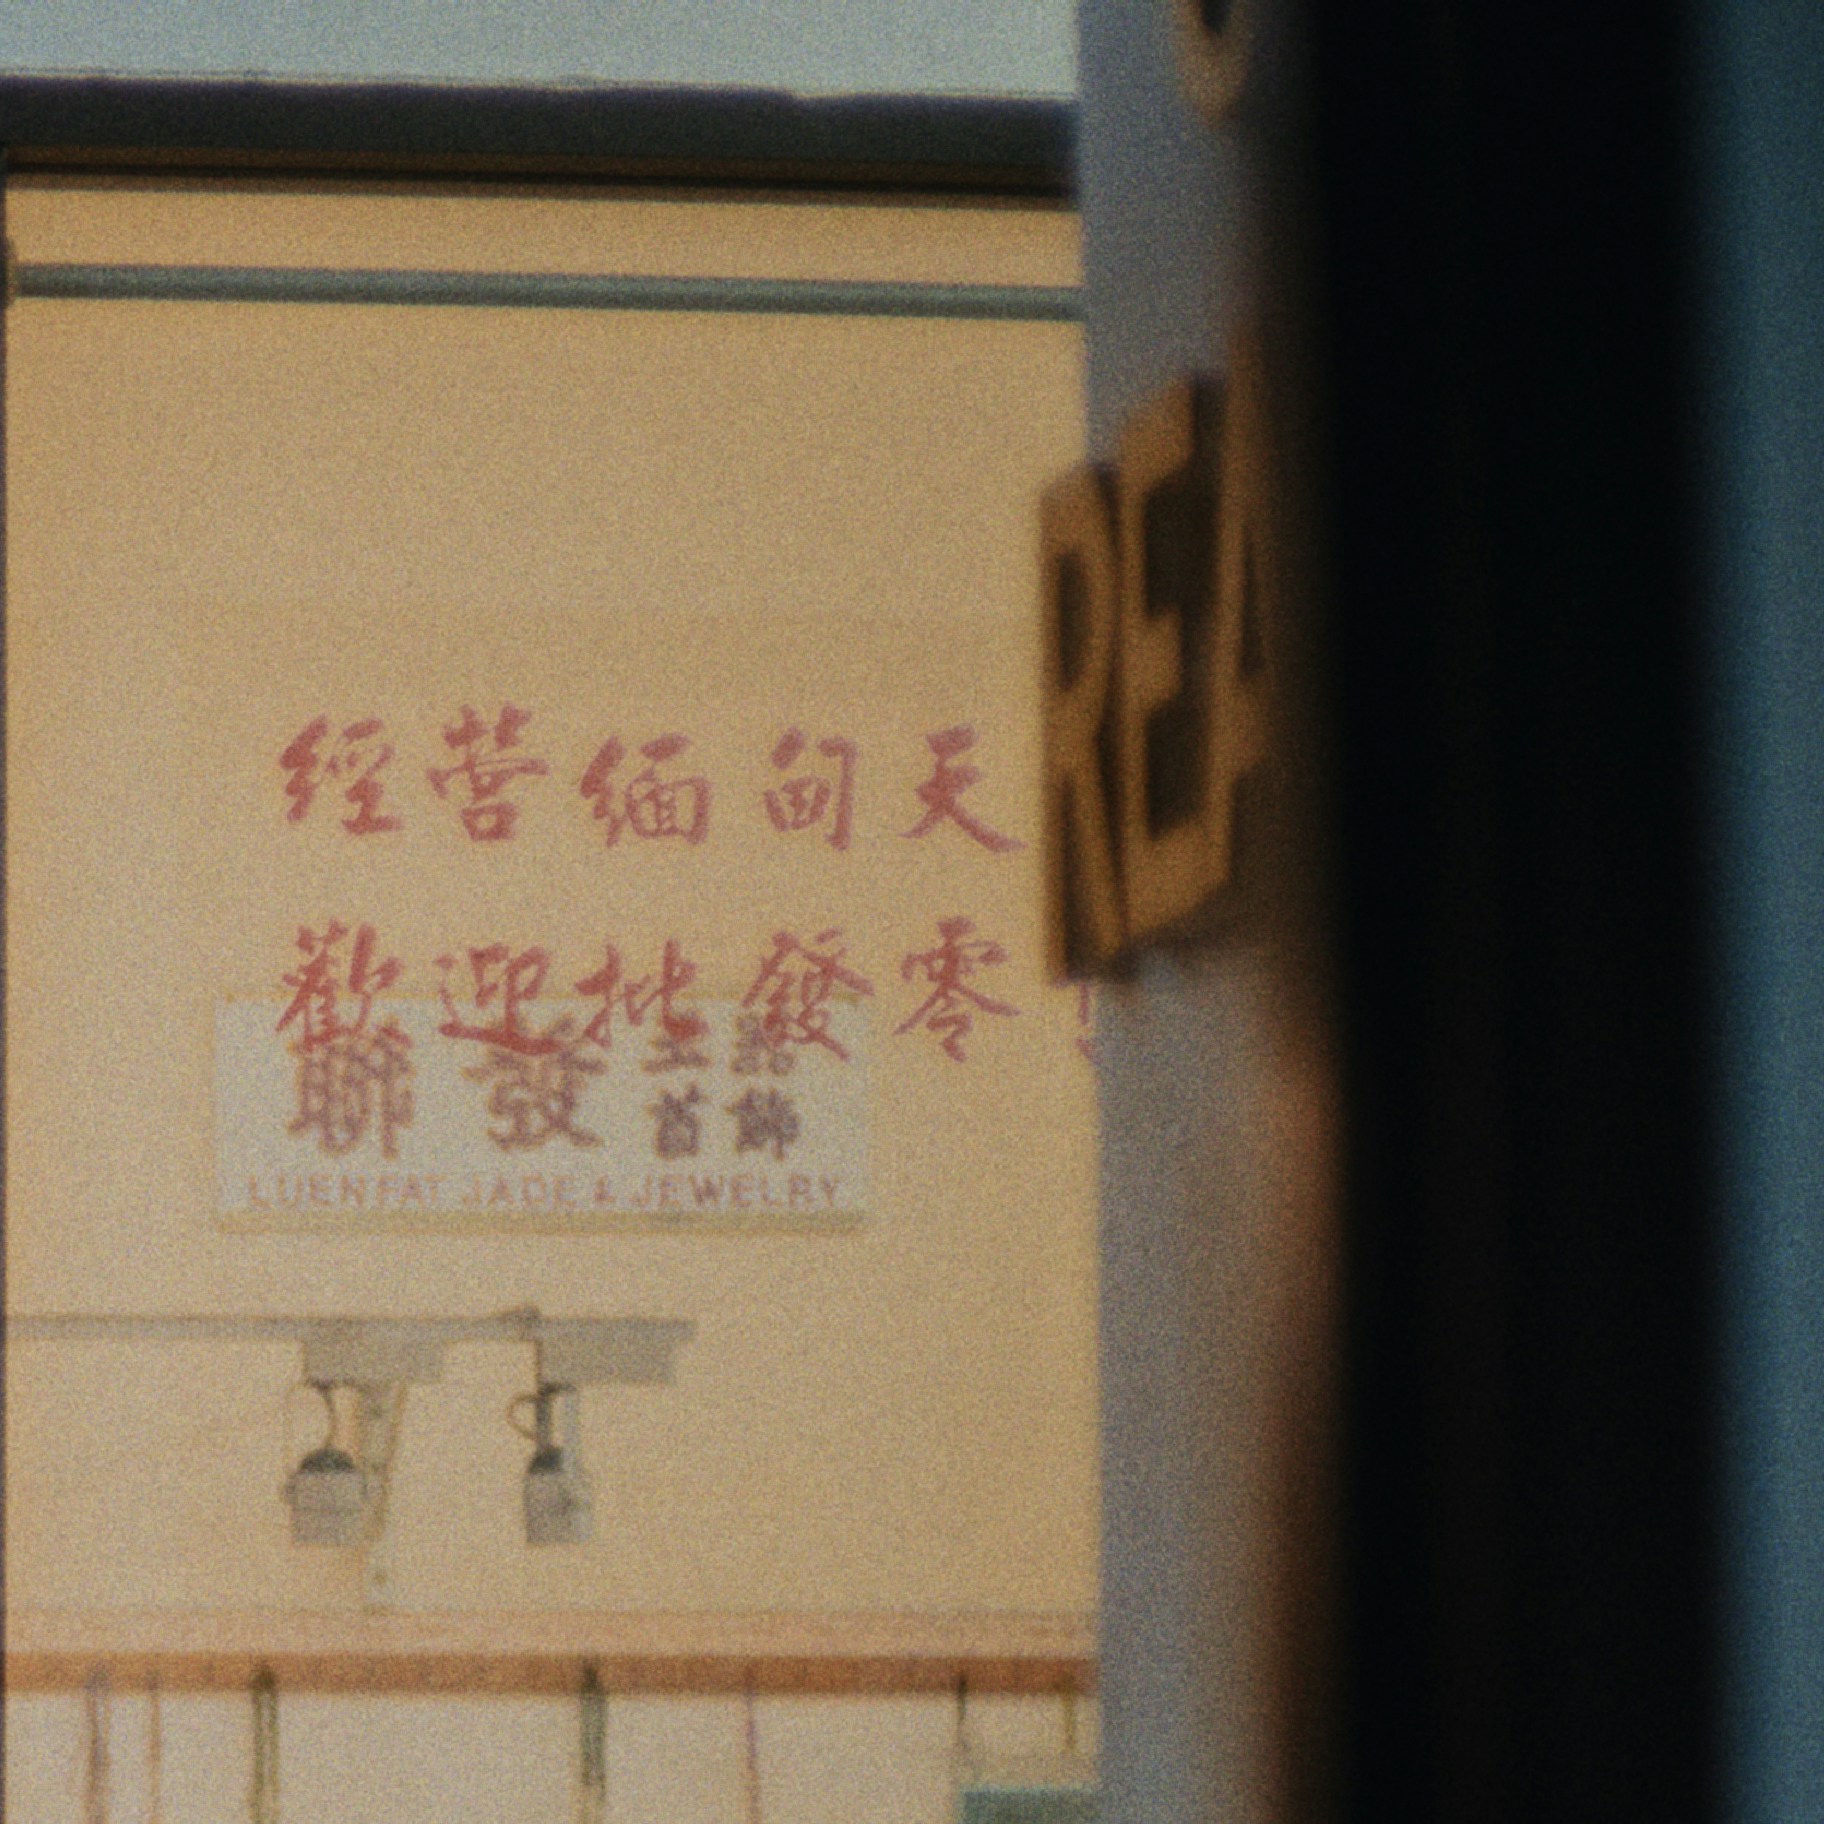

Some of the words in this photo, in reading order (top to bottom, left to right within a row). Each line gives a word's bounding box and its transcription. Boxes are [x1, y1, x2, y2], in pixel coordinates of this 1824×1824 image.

[275, 917, 1096, 1063] 歡迎批發零
[461, 1173, 576, 1208] JADE
[628, 1173, 843, 1208] JEWELRY
